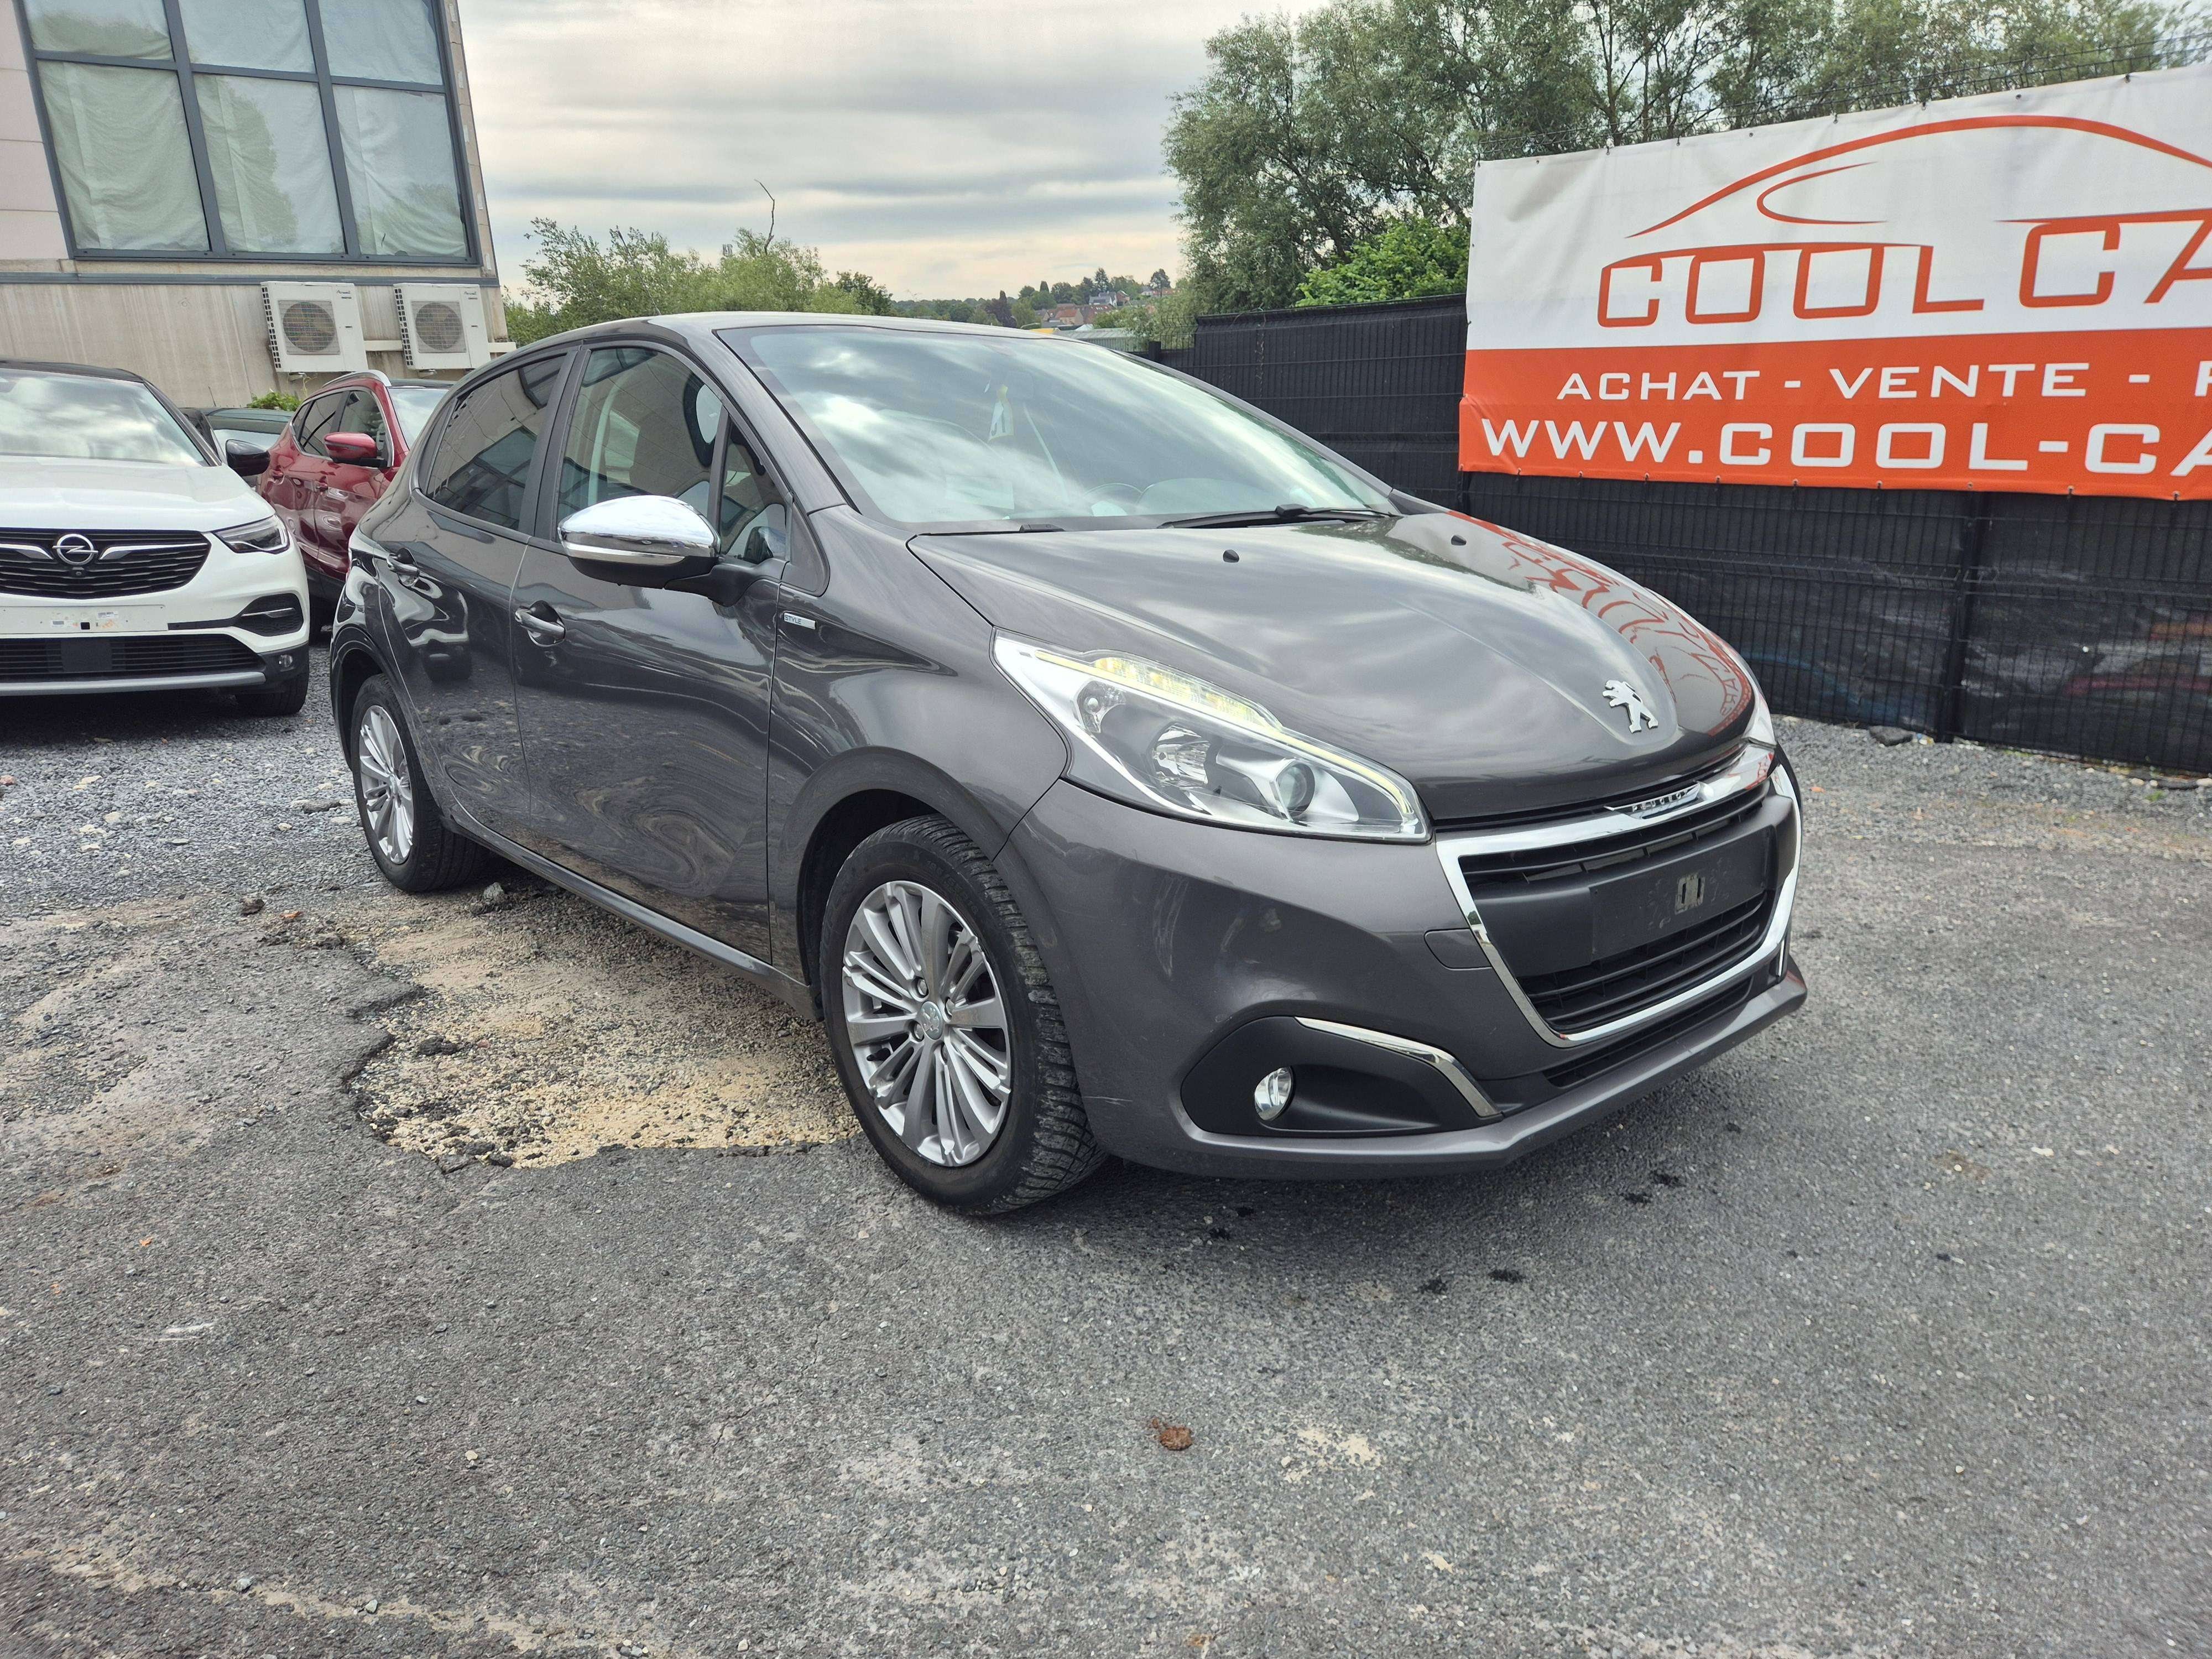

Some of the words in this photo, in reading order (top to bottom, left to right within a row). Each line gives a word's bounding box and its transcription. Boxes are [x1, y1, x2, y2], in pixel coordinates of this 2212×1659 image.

[1598, 242, 1985, 327] COOL
[1556, 371, 1760, 400] ACHAT
[1829, 363, 2089, 399] VENTE
[785, 615, 801, 624] STYLE
